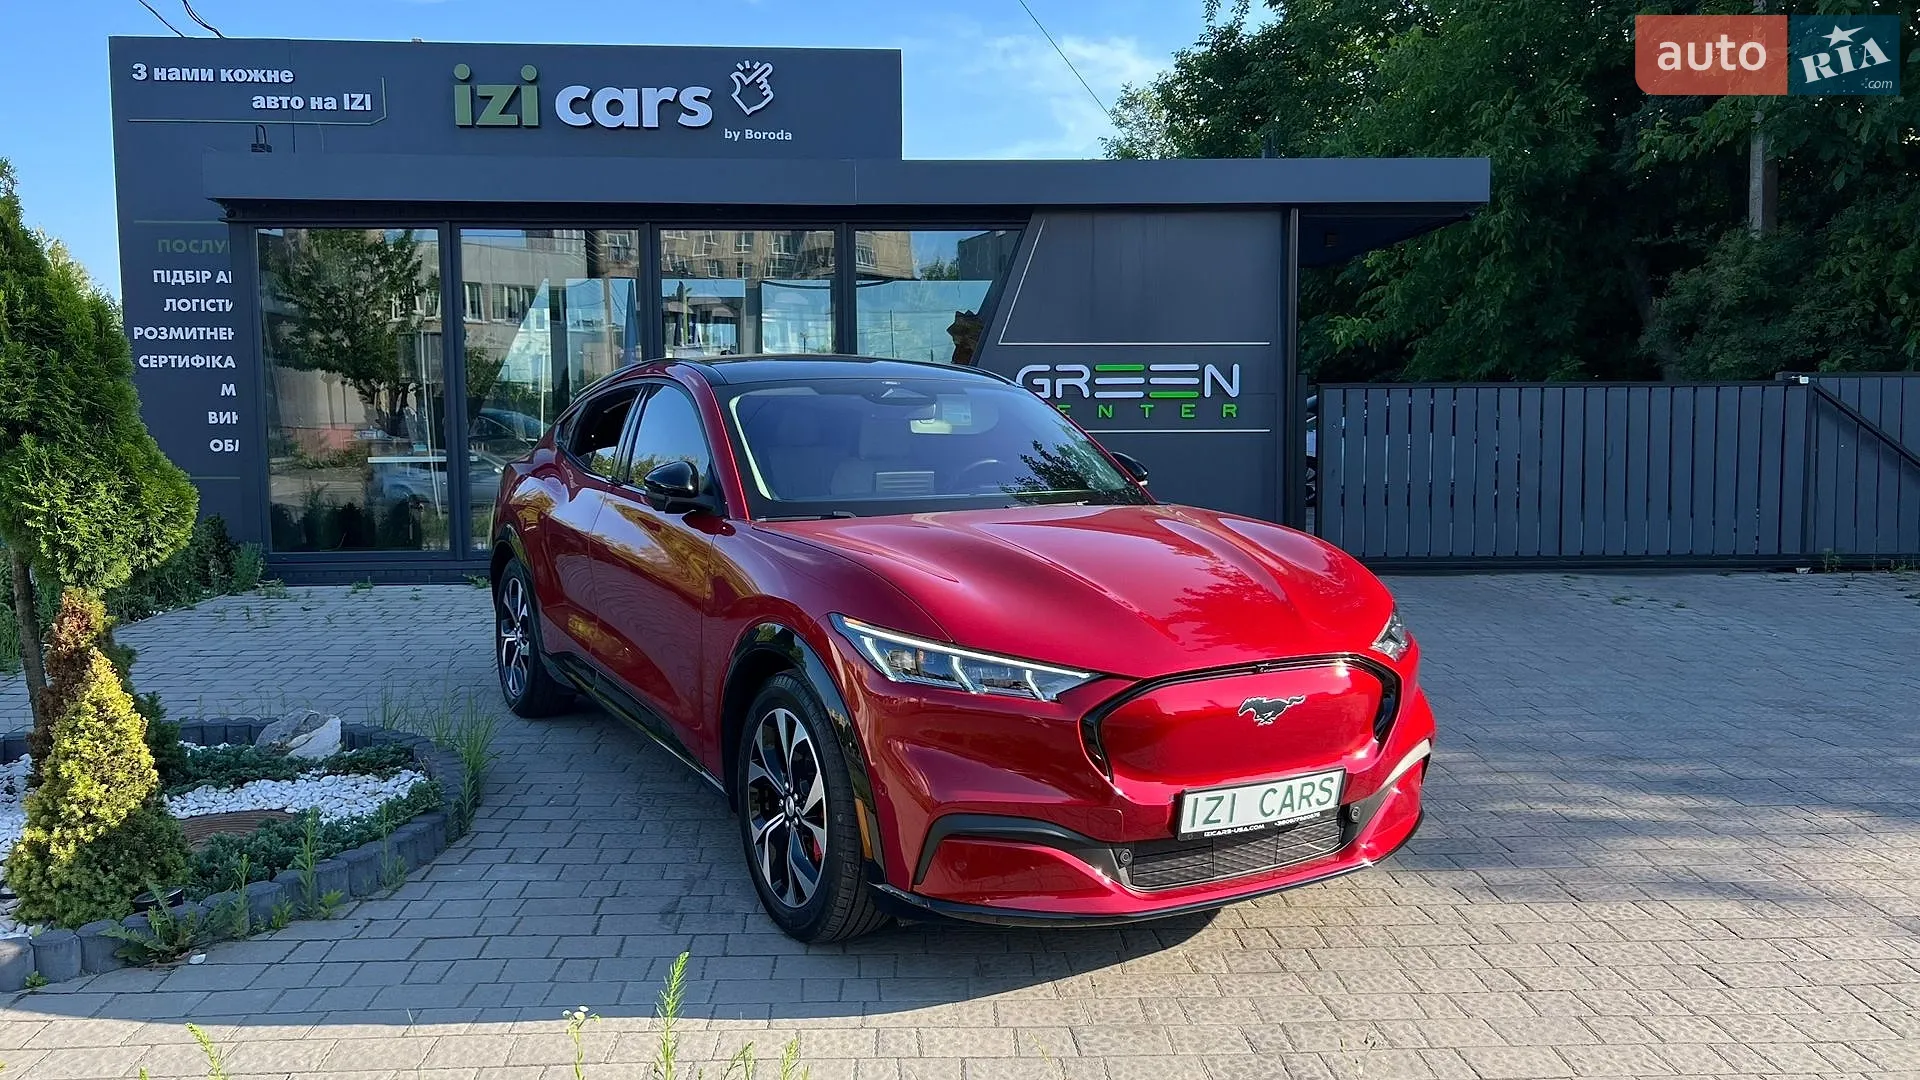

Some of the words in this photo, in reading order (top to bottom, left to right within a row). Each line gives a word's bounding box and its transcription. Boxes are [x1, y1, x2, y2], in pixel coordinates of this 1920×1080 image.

[132, 63, 148, 80] З
[154, 66, 214, 82] нами
[220, 67, 294, 83] кожне
[252, 95, 304, 110] авто
[310, 95, 337, 110] на
[343, 93, 371, 111] IZI
[454, 63, 540, 127] izi
[554, 85, 714, 128] cars
[724, 128, 740, 141] by
[744, 128, 793, 141] Boroda
[157, 239, 230, 254] ПОСЛУ
[153, 270, 212, 286] ПІДБІР
[1015, 363, 1240, 398] GREEN
[1056, 404, 1238, 418] ENTER
[1190, 793, 1237, 828] IZI
[1259, 776, 1334, 818] CARS
